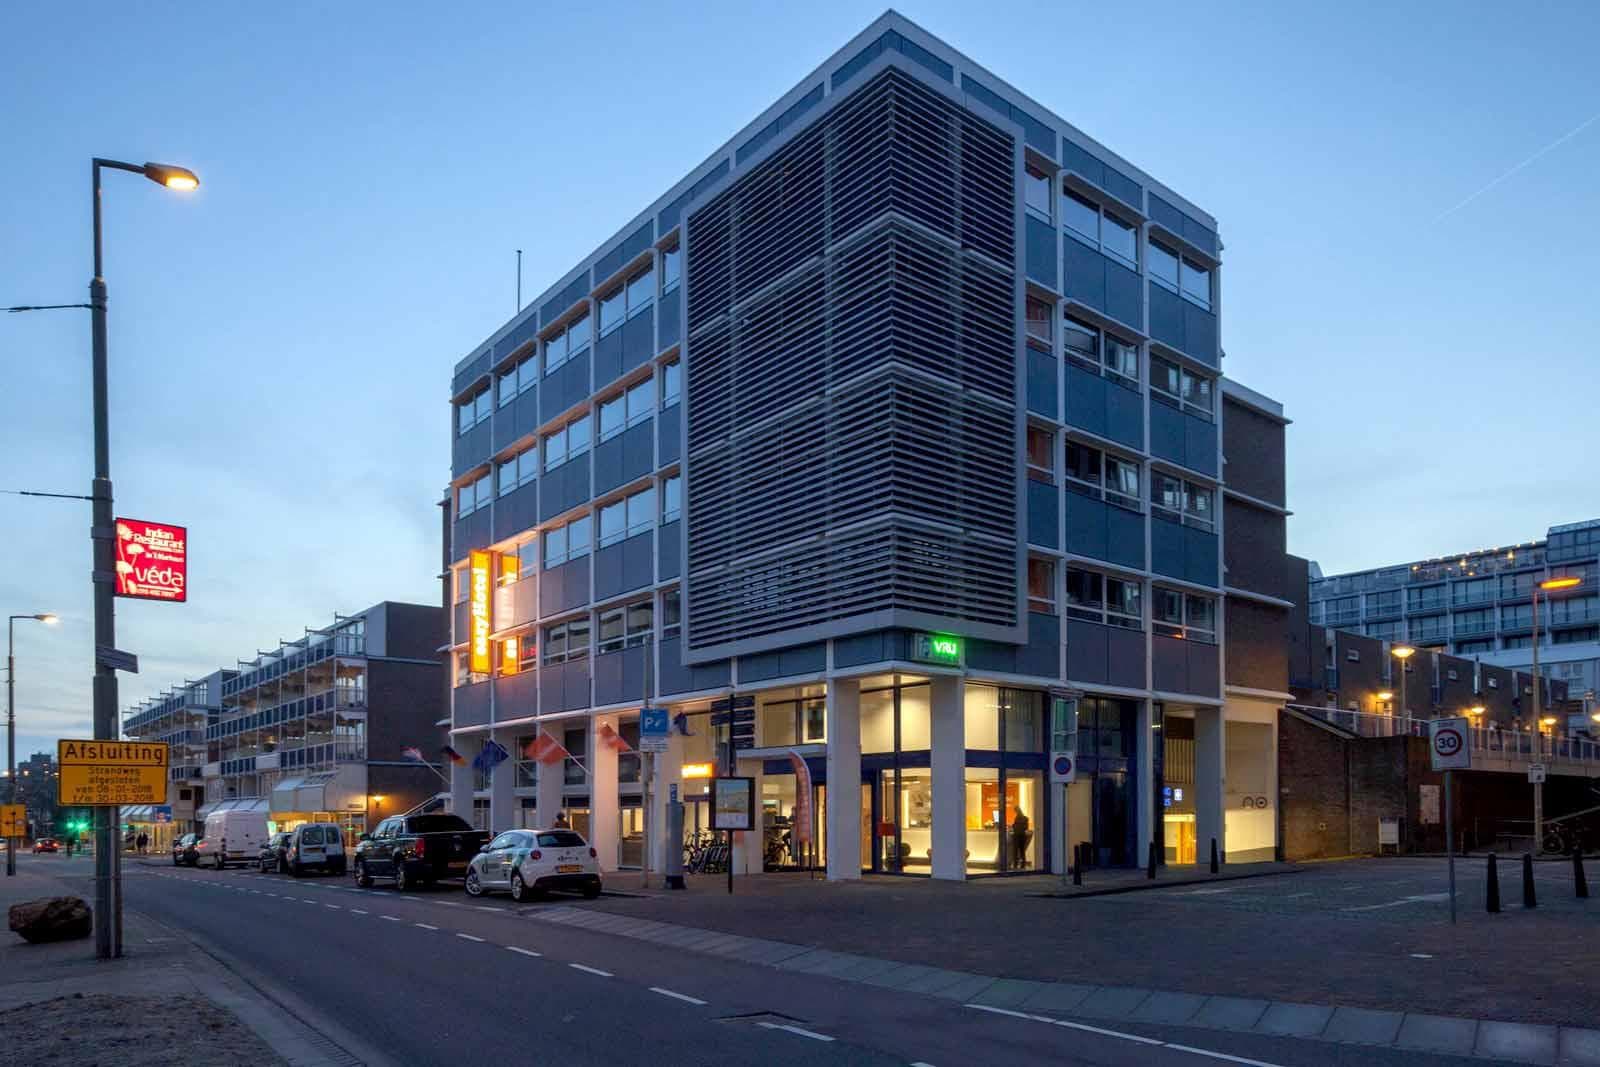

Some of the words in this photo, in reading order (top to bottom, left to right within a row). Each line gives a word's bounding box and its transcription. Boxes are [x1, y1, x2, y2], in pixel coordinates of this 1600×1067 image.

[134, 533, 184, 550] Restaurant
[145, 527, 174, 540] Indian
[135, 565, 184, 587] véda
[1439, 737, 1456, 748] 30
[64, 743, 163, 764] Afsluiting
